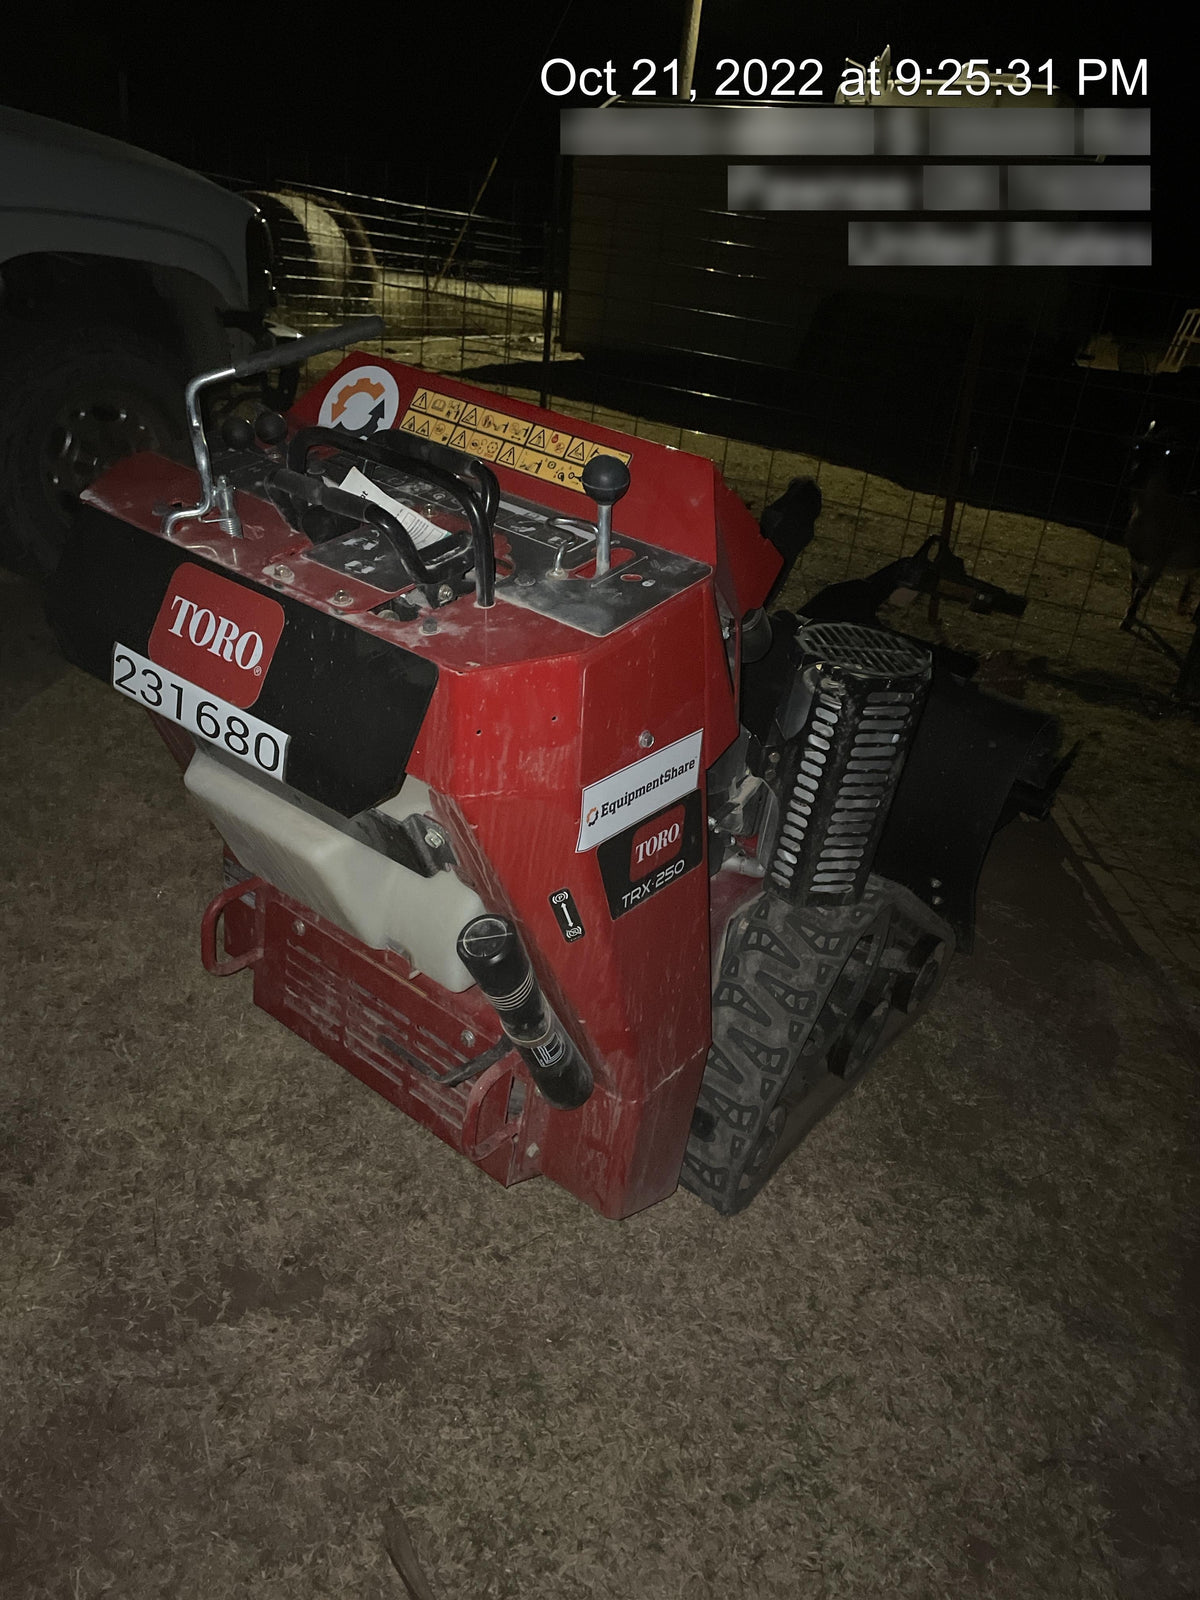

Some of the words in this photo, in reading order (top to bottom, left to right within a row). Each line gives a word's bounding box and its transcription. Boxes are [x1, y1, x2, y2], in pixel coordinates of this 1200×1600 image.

[114, 654, 280, 772] 231680
[600, 758, 696, 818] EquipmentShare
[635, 822, 680, 864] TORO
